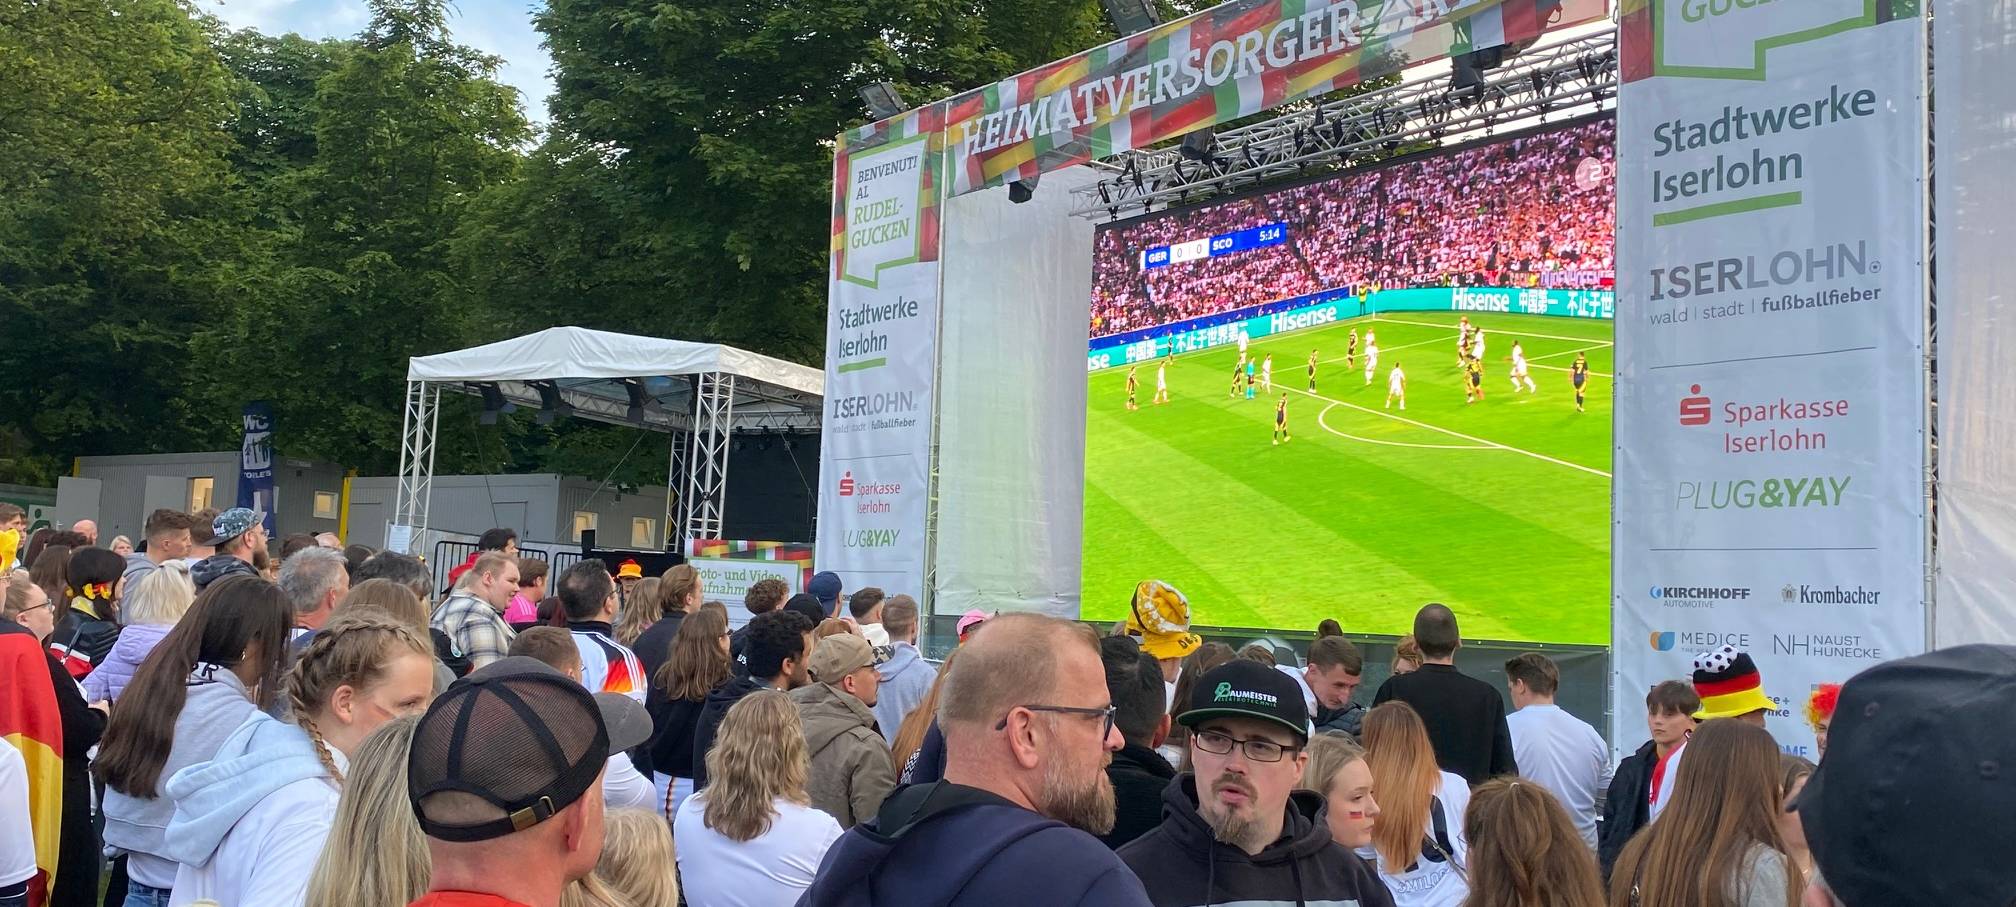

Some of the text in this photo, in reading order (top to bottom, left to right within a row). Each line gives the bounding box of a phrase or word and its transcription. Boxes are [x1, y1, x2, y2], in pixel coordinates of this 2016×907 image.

[1653, 84, 1876, 157] Stadtwerke
[1653, 148, 1803, 203] Iserlohn
[855, 185, 869, 200] AL
[852, 196, 903, 225] RUDEL-
[851, 218, 910, 249] GUCKEN
[1148, 228, 1280, 264] GER 0 0 SCO 5:14
[1649, 240, 1866, 301] ISERLOHN
[839, 296, 918, 331] Stadtwerke
[1451, 287, 1510, 313] Hisense
[1650, 287, 1882, 326] wald stadt fußballfieber
[1271, 306, 1337, 333] Hisense
[838, 330, 888, 359] Iserlohn
[833, 391, 912, 419] ISERLOHN
[1724, 398, 1849, 427] Sparkasse
[243, 414, 269, 430] WC
[1725, 430, 1826, 453] Iserlohn
[857, 482, 901, 498] Sparkasse
[1677, 476, 1851, 509] PLUG&YAY
[725, 568, 746, 581] und
[1663, 584, 1881, 605] KIRCHHOFF Krombacher
[1663, 600, 1714, 609] AUTOMOTIVE
[1681, 631, 1861, 656] MEDICE NH NAUST
[1214, 681, 1278, 704] BAUMEISTER
